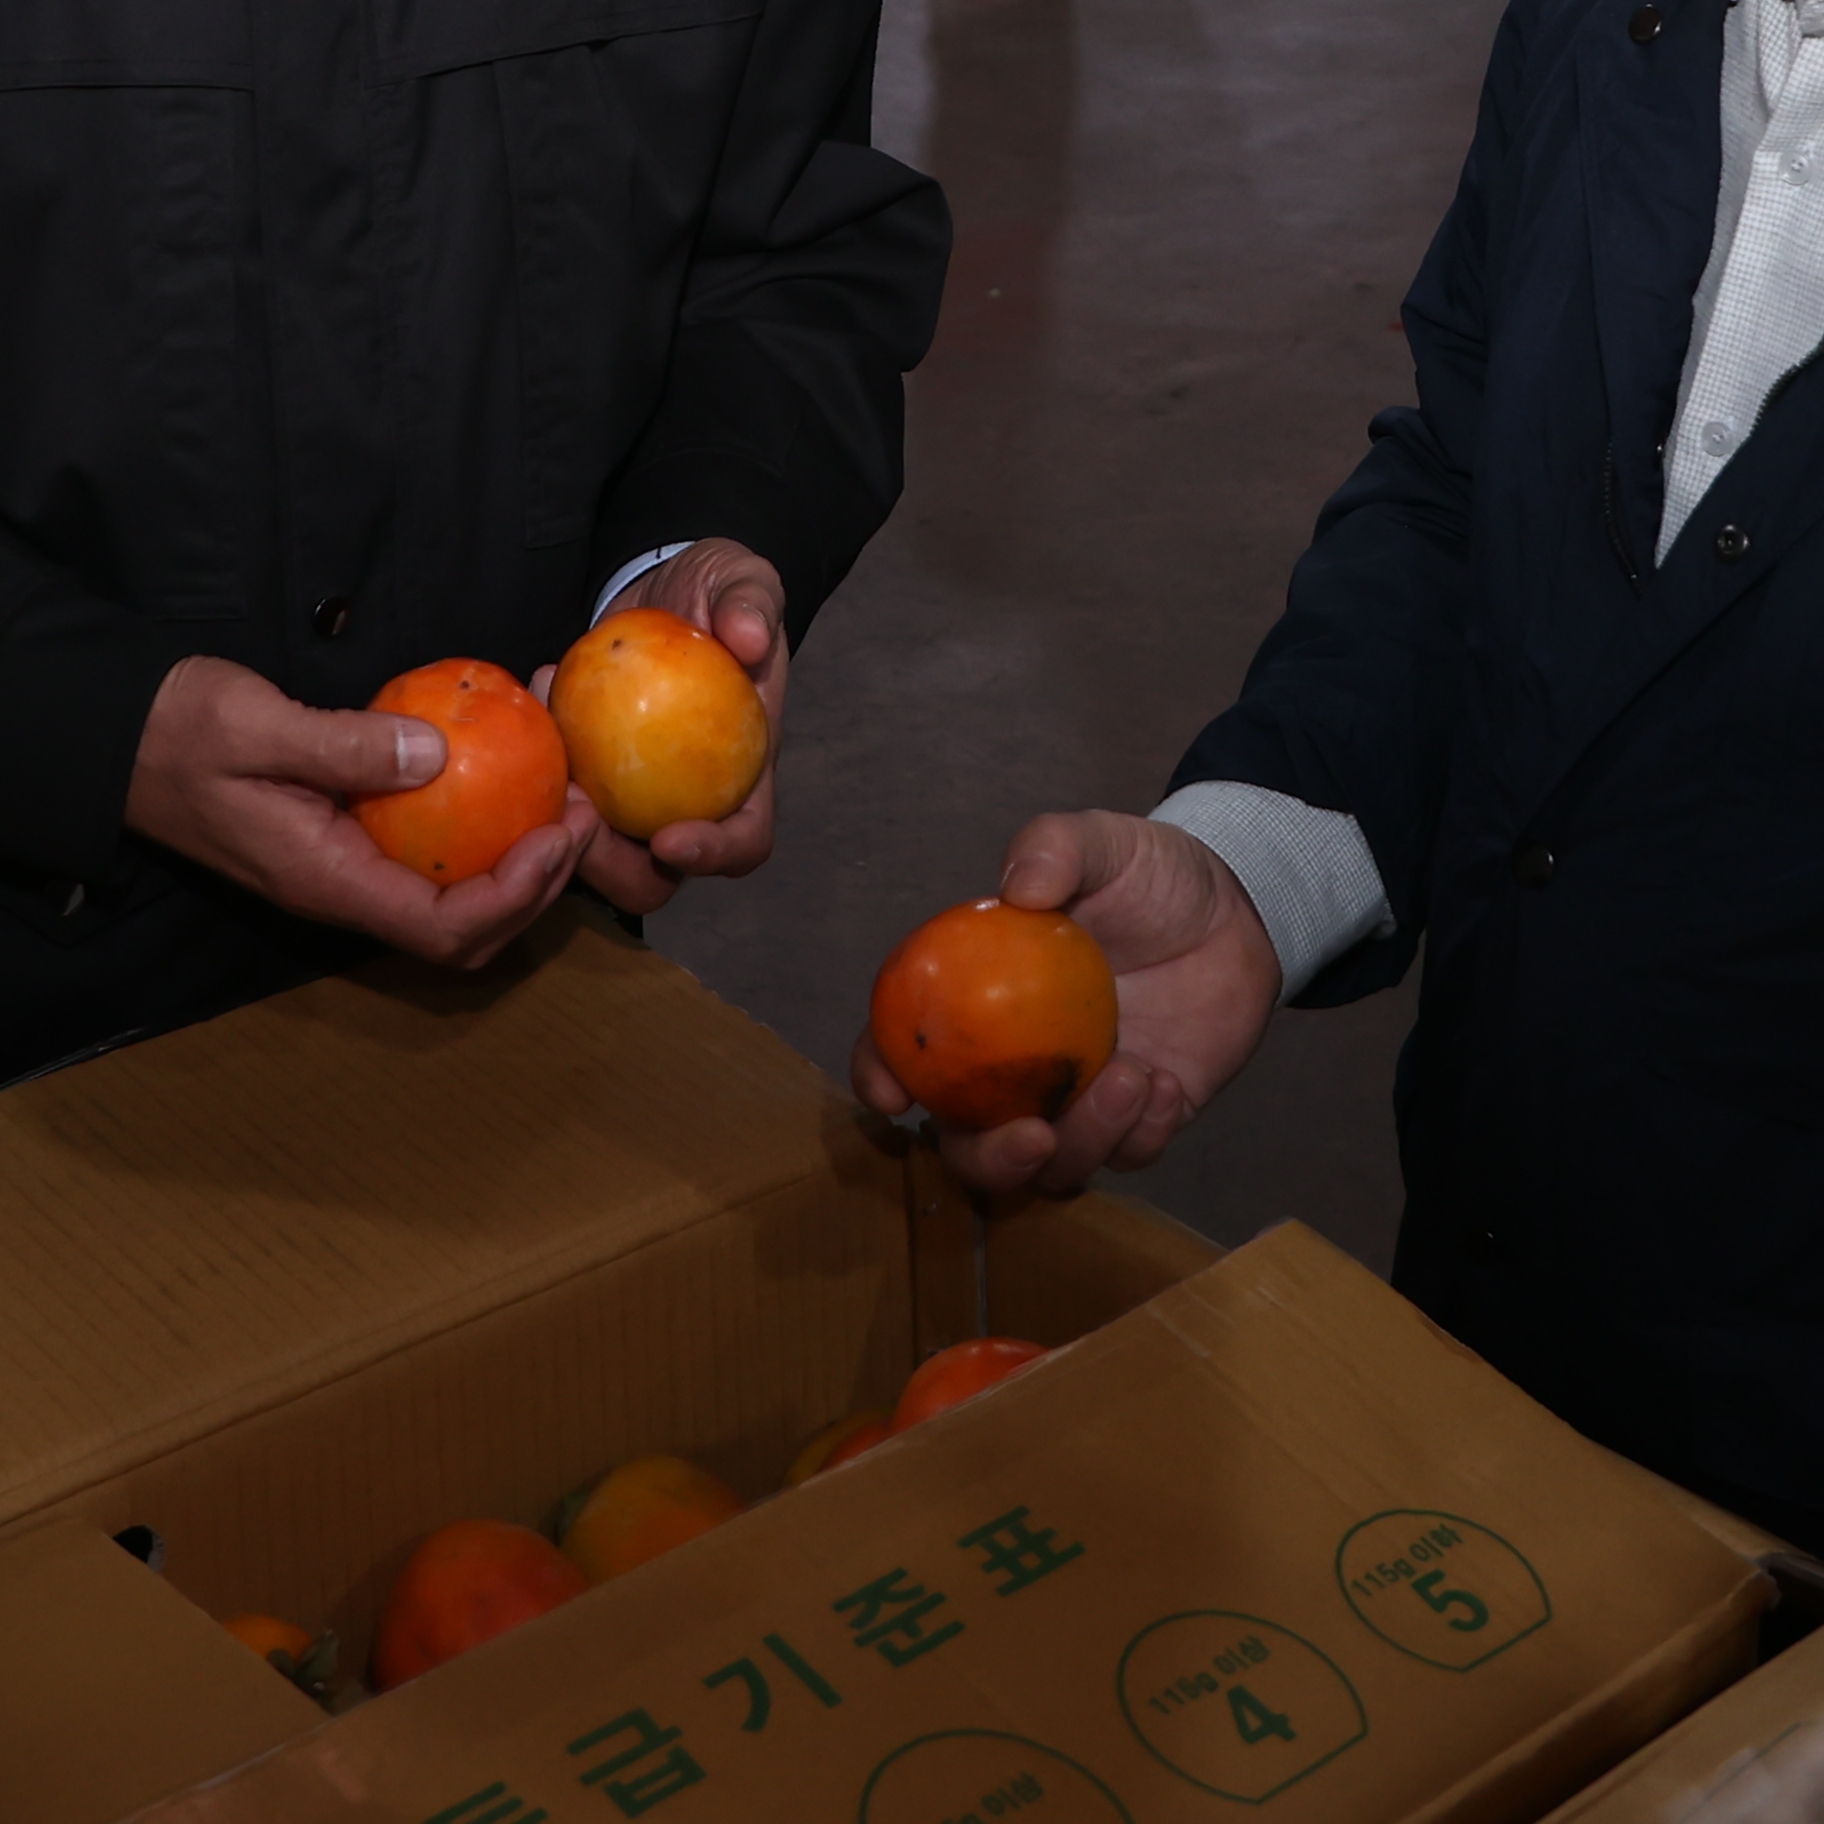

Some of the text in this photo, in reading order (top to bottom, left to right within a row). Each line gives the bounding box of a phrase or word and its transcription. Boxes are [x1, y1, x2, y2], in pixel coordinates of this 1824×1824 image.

[1351, 1522, 1464, 1598] 115g 이하
[1411, 1569, 1490, 1632] 5
[1212, 1634, 1271, 1677] 이상
[1227, 1684, 1297, 1745] 4
